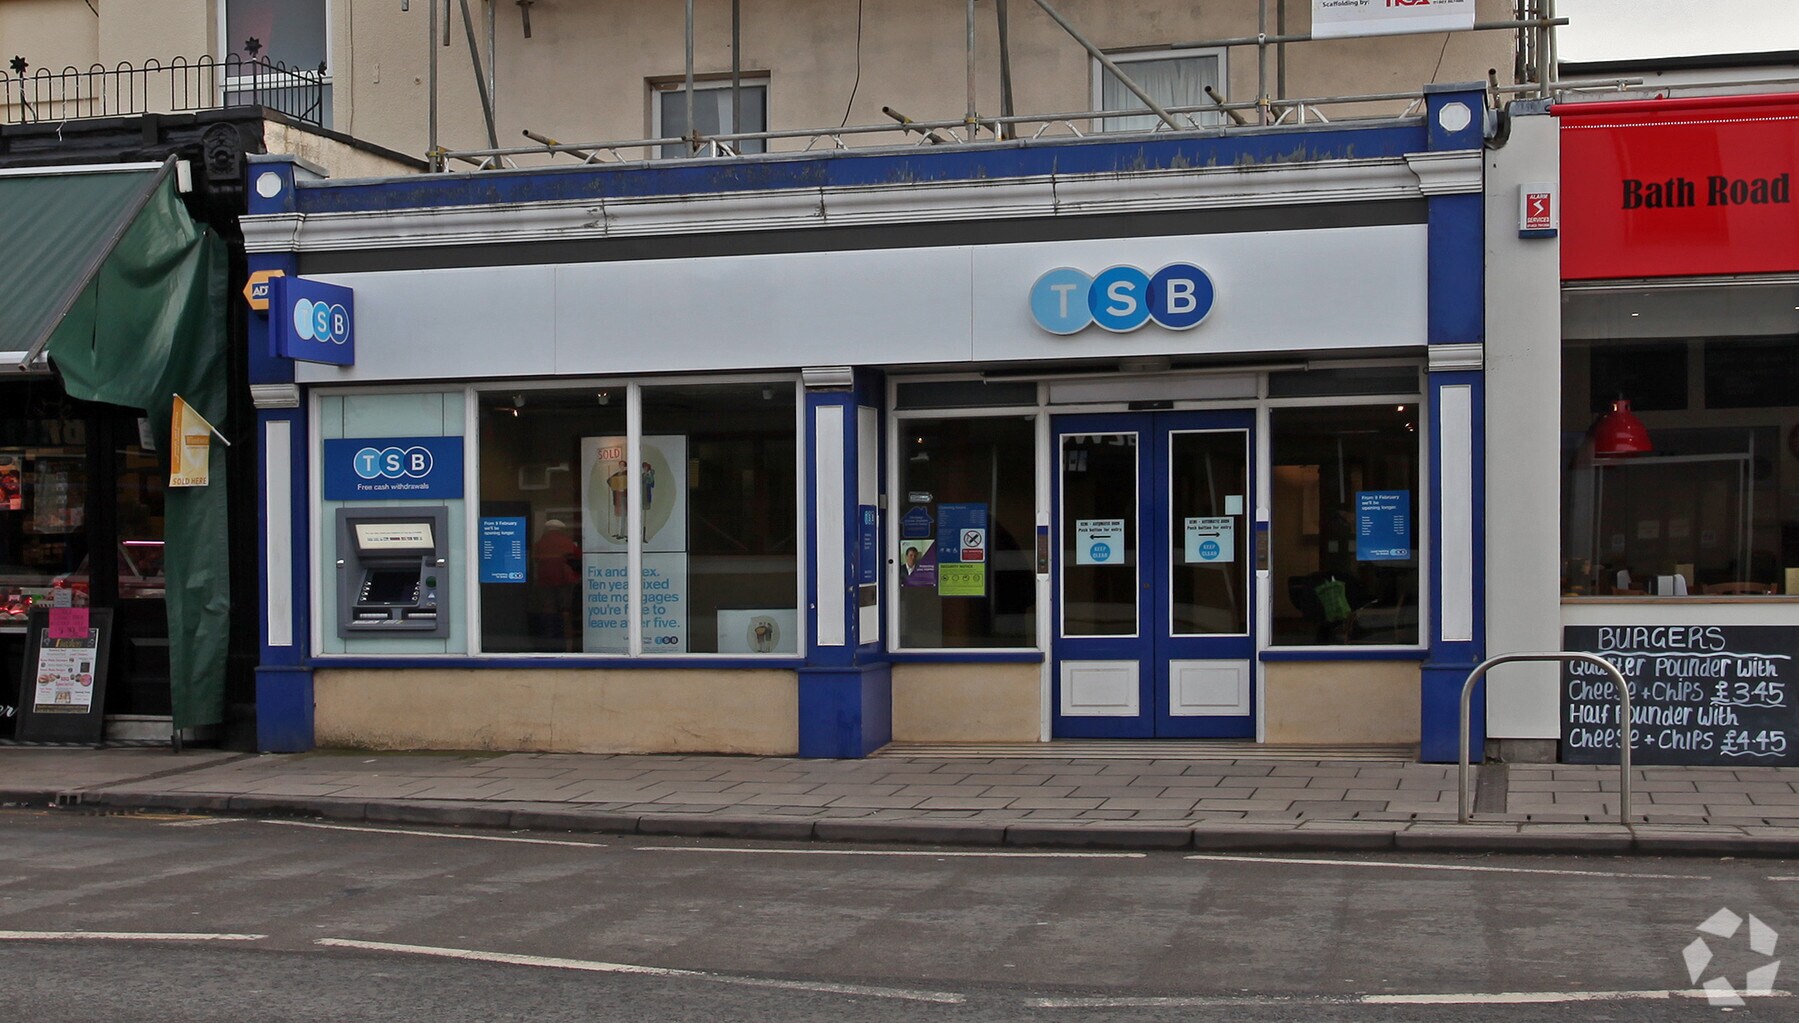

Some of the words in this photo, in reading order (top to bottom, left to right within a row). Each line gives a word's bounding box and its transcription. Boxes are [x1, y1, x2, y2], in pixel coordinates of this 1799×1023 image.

[1621, 177, 1695, 210] Bath
[1706, 173, 1790, 207] Road
[1051, 279, 1197, 318] TSB
[302, 307, 344, 335] TSB
[597, 448, 620, 460] SOLD
[363, 454, 425, 471] TSB
[374, 483, 390, 491] cash
[588, 566, 603, 577] Fix
[605, 566, 628, 577] and
[588, 579, 606, 590] Ten
[588, 592, 608, 603] rate
[611, 593, 679, 604] mogages
[588, 605, 621, 616] you're
[624, 604, 649, 615] fe
[653, 605, 666, 615] to
[588, 617, 617, 628] leave
[620, 619, 651, 628] aer
[653, 617, 680, 628] five.
[1598, 627, 1726, 652] BURGERS
[1569, 704, 1610, 724] Half
